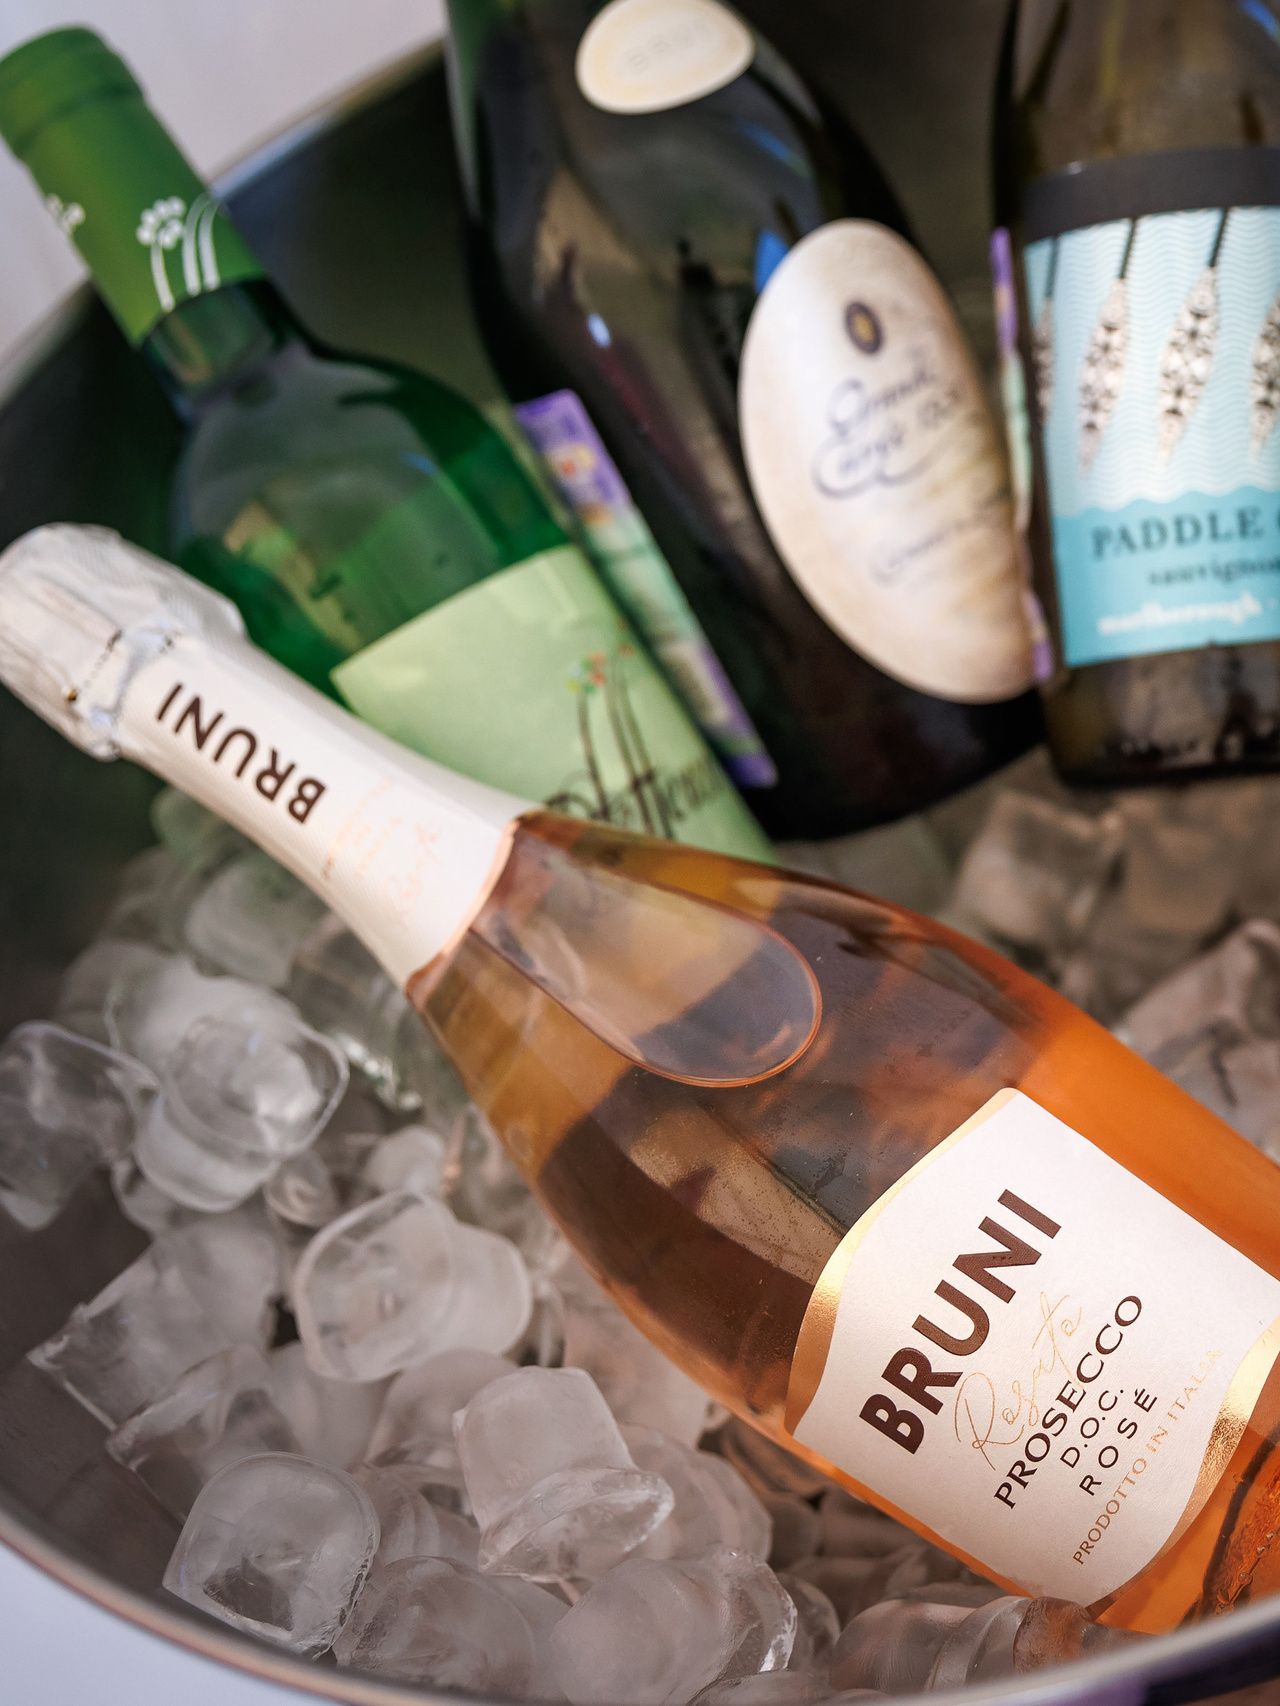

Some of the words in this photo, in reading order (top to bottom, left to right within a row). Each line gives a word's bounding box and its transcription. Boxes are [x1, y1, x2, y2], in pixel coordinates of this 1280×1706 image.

[1091, 505, 1265, 560] PADDLE
[157, 682, 327, 824] BRUNI
[859, 1189, 1062, 1455] BRUNI
[994, 1295, 1143, 1510] PROSECCO
[1060, 1389, 1124, 1469] D.O.C.
[1072, 1457, 1148, 1565] PRODOTTO
[1146, 1425, 1169, 1453] IN
[1167, 1350, 1224, 1422] ITALIA
[1079, 1387, 1158, 1496] ROSÉ
